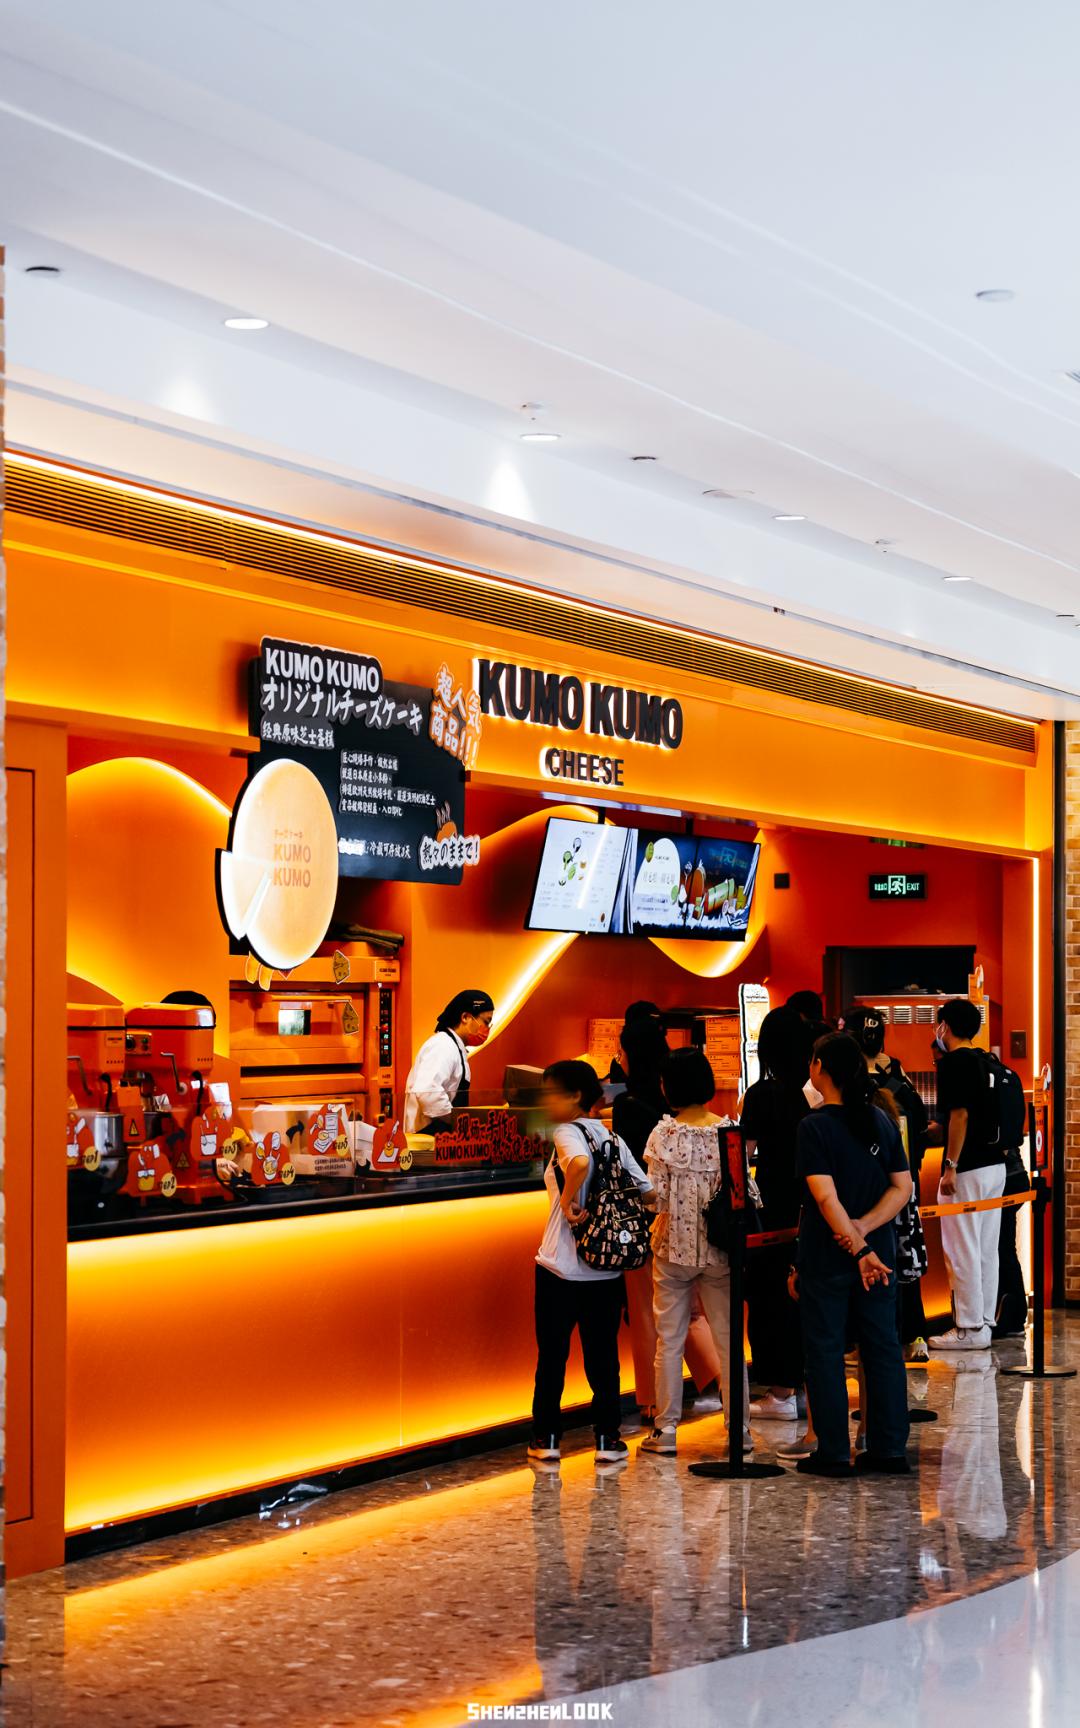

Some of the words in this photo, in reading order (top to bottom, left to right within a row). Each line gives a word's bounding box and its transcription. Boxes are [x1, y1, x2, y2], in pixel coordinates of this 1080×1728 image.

[265, 647, 323, 683] KUMO
[327, 658, 380, 693] KUMO
[262, 676, 423, 732] オリジナルチーズケーキ
[478, 658, 584, 731] KUMO
[588, 682, 684, 750] KUMO
[546, 747, 624, 787] CHEESE
[274, 844, 311, 864] KUMO
[273, 867, 311, 888] KUMO
[906, 882, 920, 891] EXIT
